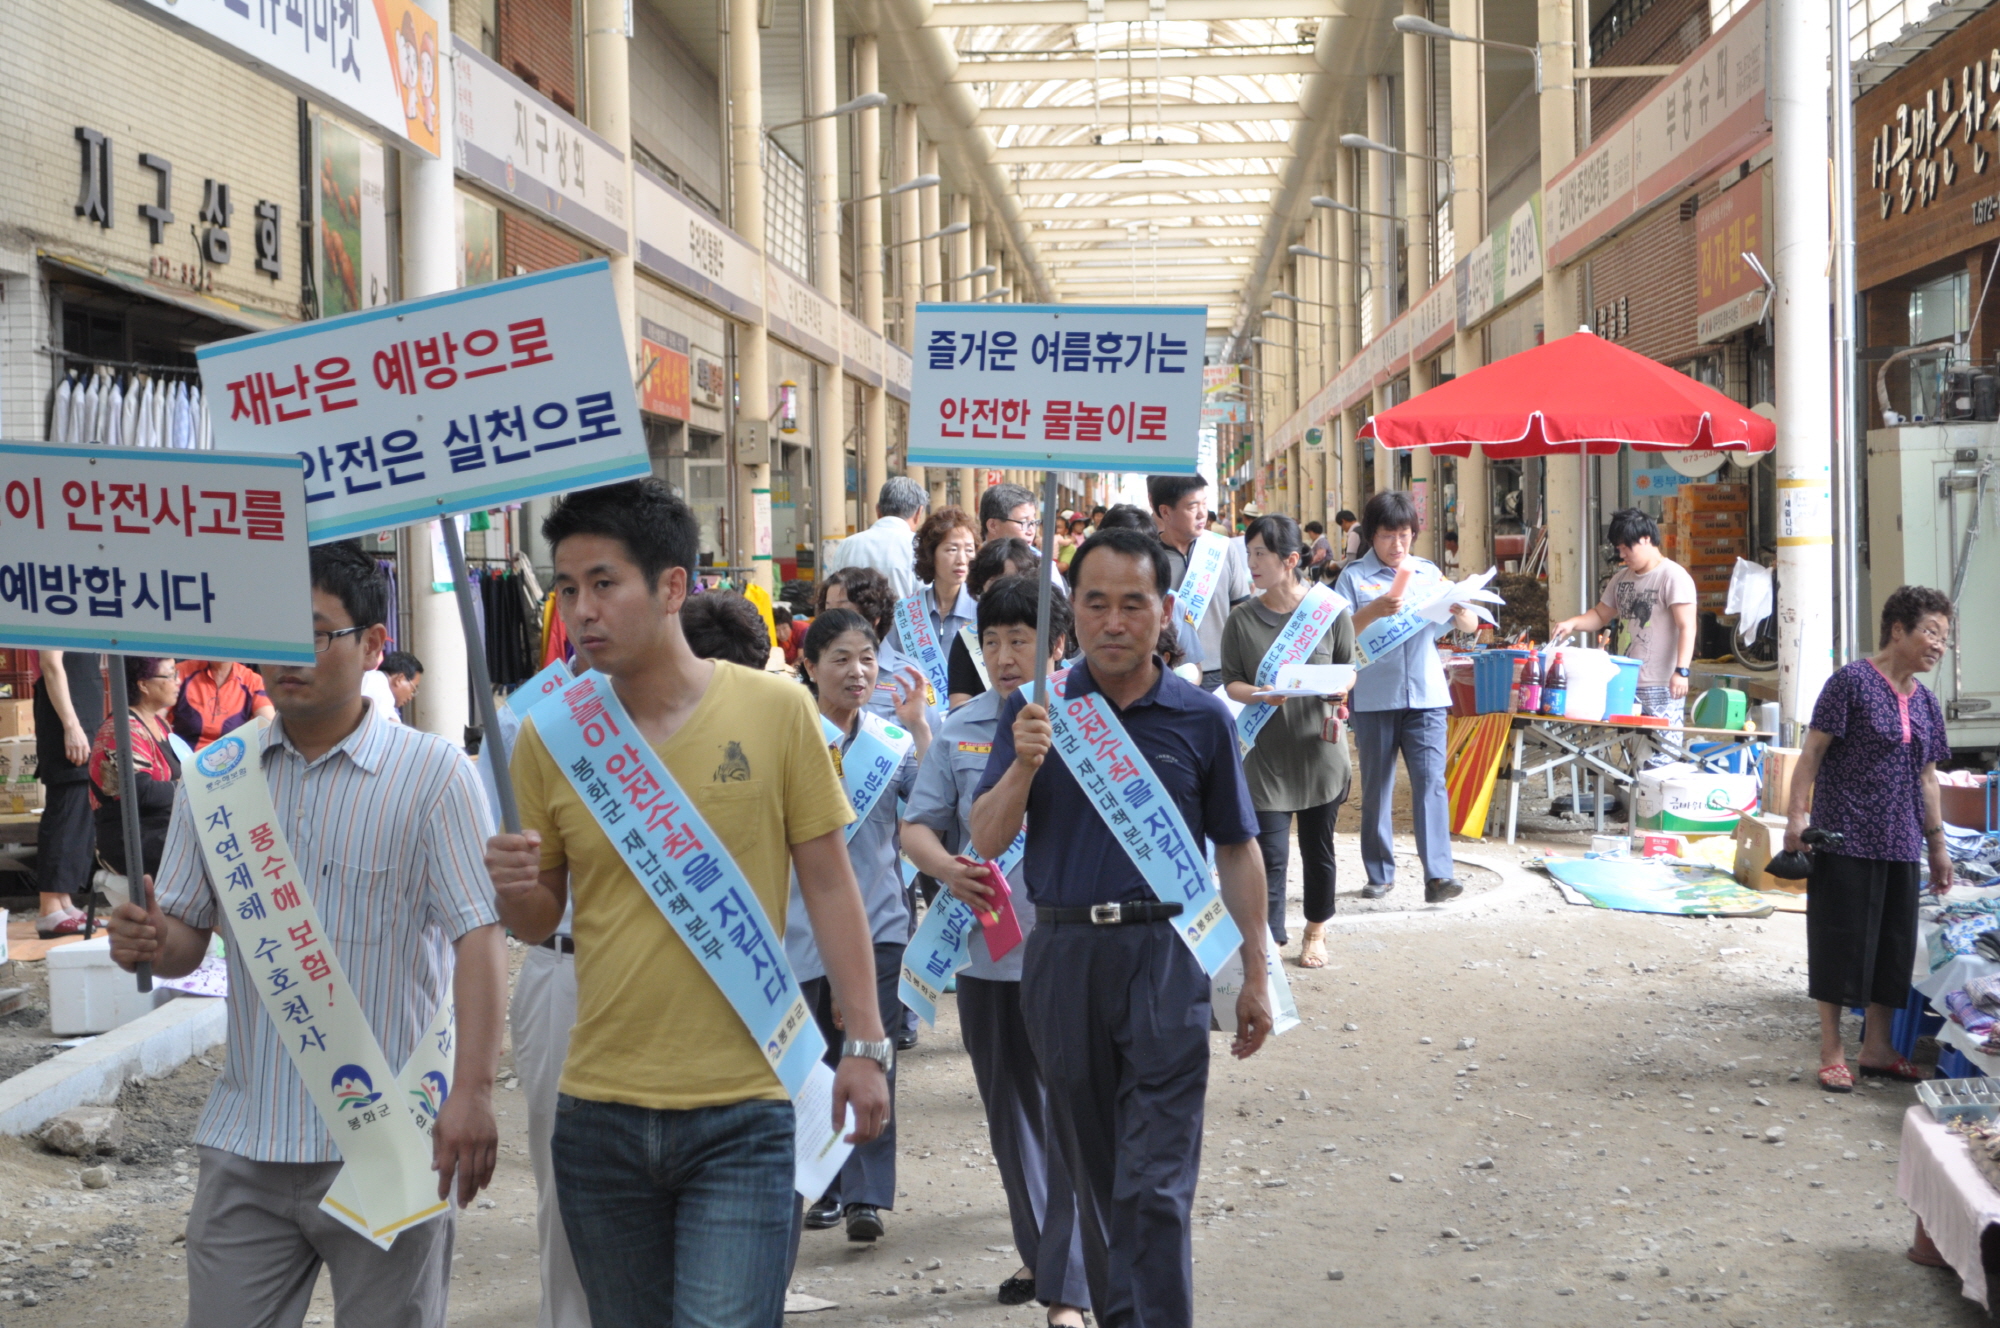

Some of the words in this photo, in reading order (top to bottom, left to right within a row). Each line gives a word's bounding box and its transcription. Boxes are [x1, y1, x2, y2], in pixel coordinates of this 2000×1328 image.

[514, 98, 585, 198] 지구상회
[75, 126, 282, 281] 지구상회
[1701, 212, 1756, 298] 전자랜드
[225, 356, 359, 427] 재난은
[372, 316, 555, 397] 예방으로
[927, 330, 1018, 372] 즐거운
[1031, 330, 1188, 374] 여름휴가는
[295, 429, 426, 504] 안전은
[442, 390, 622, 474] 실천으로
[939, 397, 1031, 440] 안전한
[1042, 399, 1168, 444] 물놀이로
[0, 477, 44, 529] 이
[61, 479, 285, 541] 안전사고를
[1653, 475, 1694, 489] 동부화
[0, 561, 216, 623] 예방합시다
[906, 599, 938, 663] 안전수칙을
[1368, 618, 1414, 655] 지킵시다
[570, 756, 626, 825] 봉화군
[1067, 693, 1155, 810] 안전수칙을
[1143, 805, 1206, 901] 지킵시다
[562, 678, 621, 748] 물놀이
[605, 742, 724, 894] 안전수칙을
[710, 886, 788, 1007] 지킵시다
[205, 804, 267, 921] 자연재해
[254, 936, 327, 1054] 수호천사
[248, 822, 301, 912] 풍수해
[287, 919, 334, 1008] 보험!
[1196, 901, 1223, 933] 봉화군
[925, 950, 953, 979] 날
[777, 1003, 805, 1045] 봉화군
[347, 1103, 391, 1131] 봉화군
